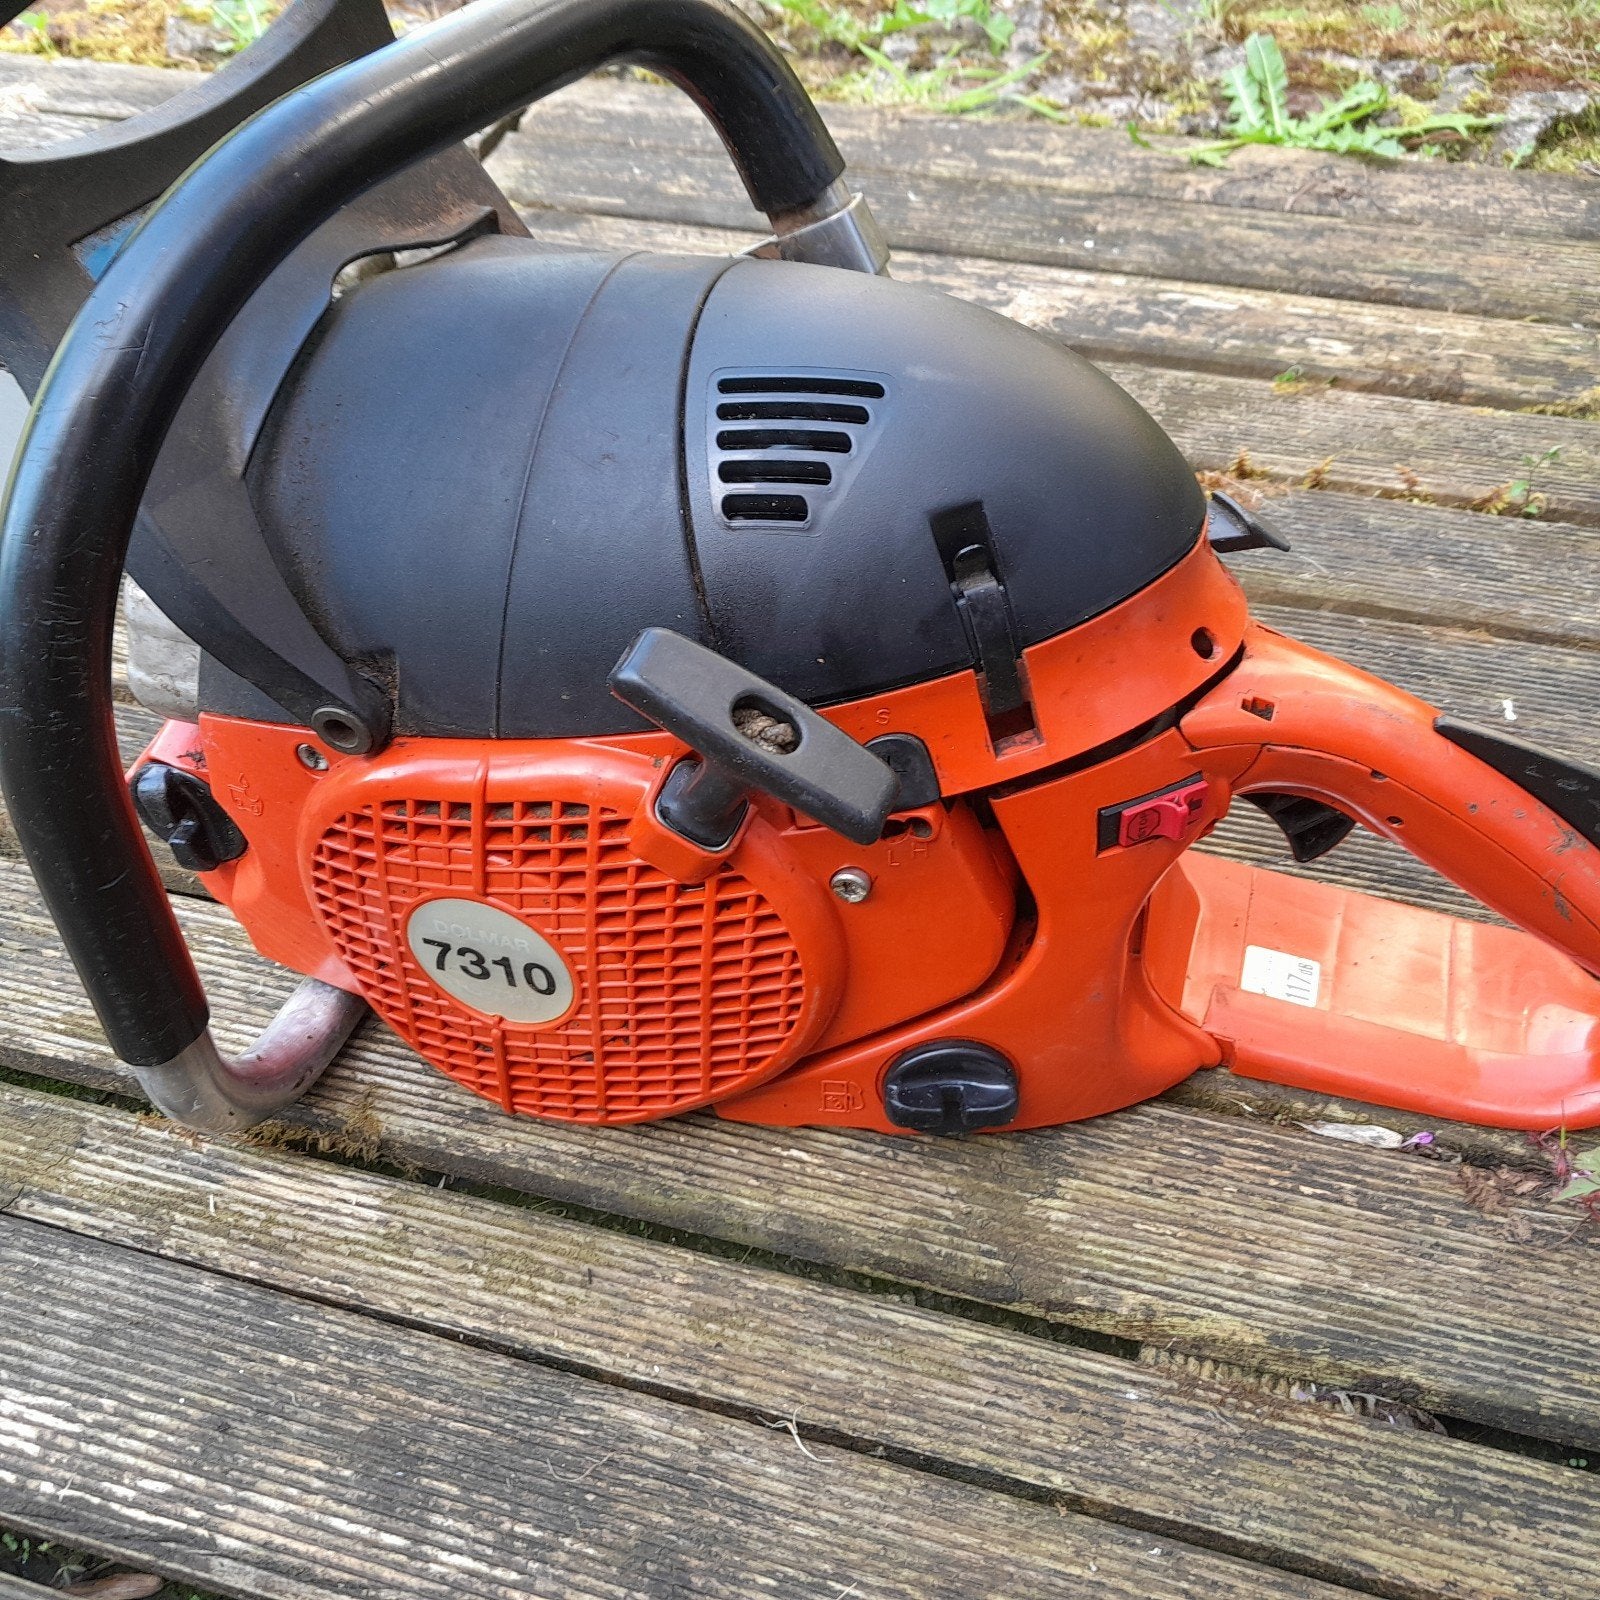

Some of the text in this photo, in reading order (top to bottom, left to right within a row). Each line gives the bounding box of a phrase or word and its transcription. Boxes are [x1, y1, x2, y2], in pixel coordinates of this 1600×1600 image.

[875, 708, 890, 725] S
[431, 918, 531, 954] DOLMAR
[421, 936, 557, 996] 7310
[1285, 972, 1312, 1001] 117
